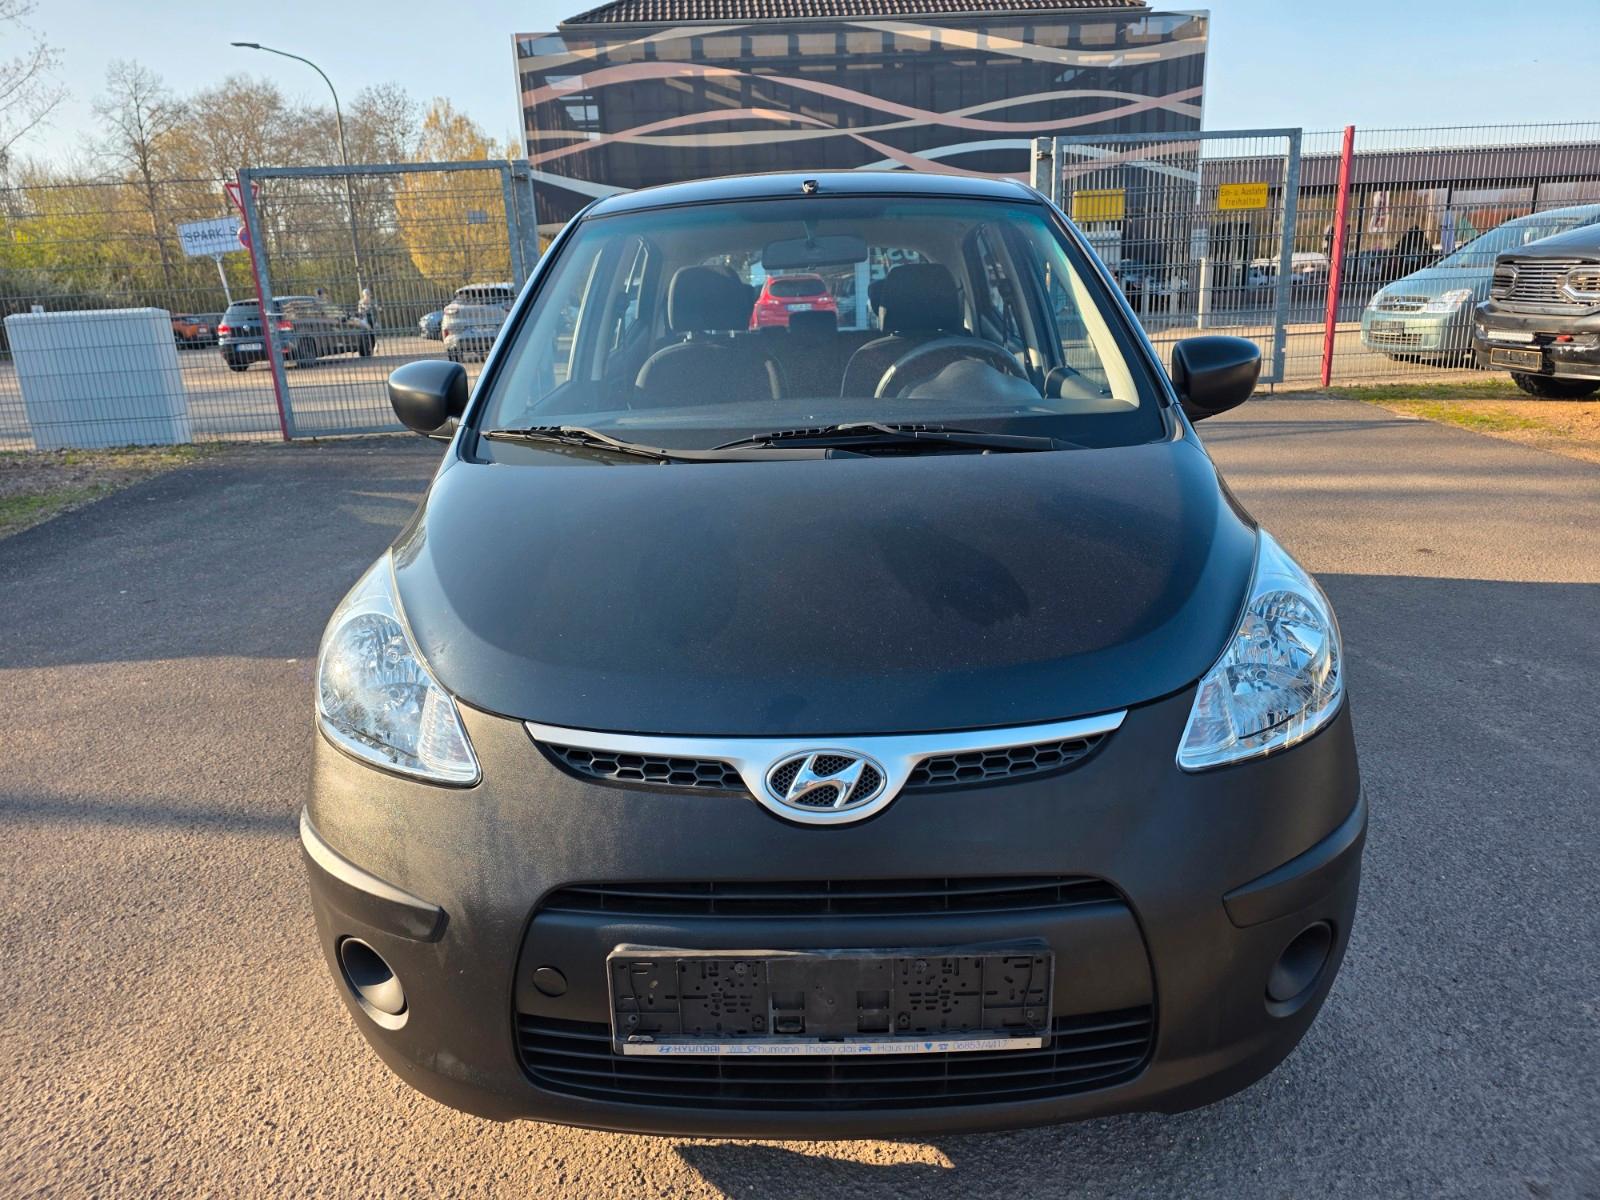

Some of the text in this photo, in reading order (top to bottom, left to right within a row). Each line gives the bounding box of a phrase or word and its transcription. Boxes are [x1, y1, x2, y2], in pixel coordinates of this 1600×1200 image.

[1241, 186, 1266, 195] Ausfahrt
[1225, 197, 1261, 206] freihalten
[184, 228, 223, 242] SPARK
[674, 1045, 720, 1053] HYUNDAI
[877, 1044, 904, 1053] Haus
